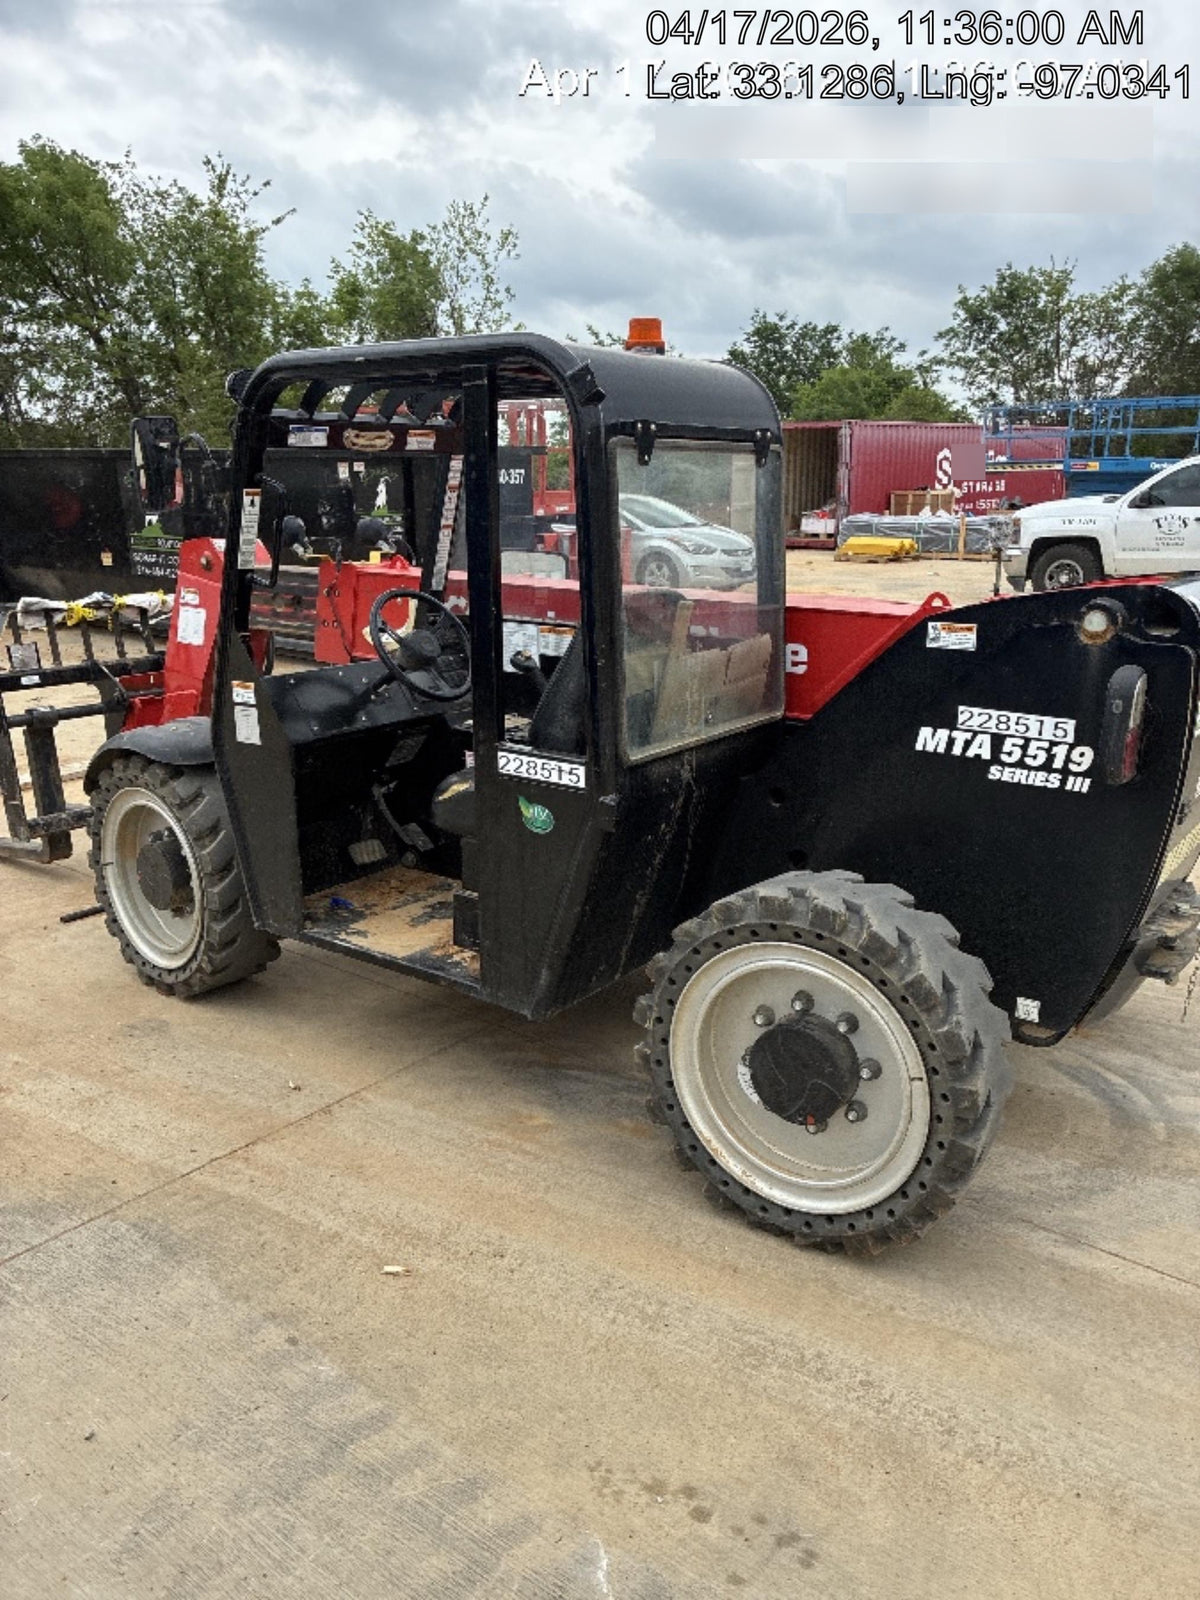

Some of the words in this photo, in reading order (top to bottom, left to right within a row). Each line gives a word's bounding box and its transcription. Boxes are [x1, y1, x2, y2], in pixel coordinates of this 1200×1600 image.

[959, 709, 1069, 739] 228515
[915, 726, 992, 760] MTA
[1000, 737, 1094, 772] 5519
[499, 755, 581, 785] 228515
[987, 765, 1062, 789] SERIES
